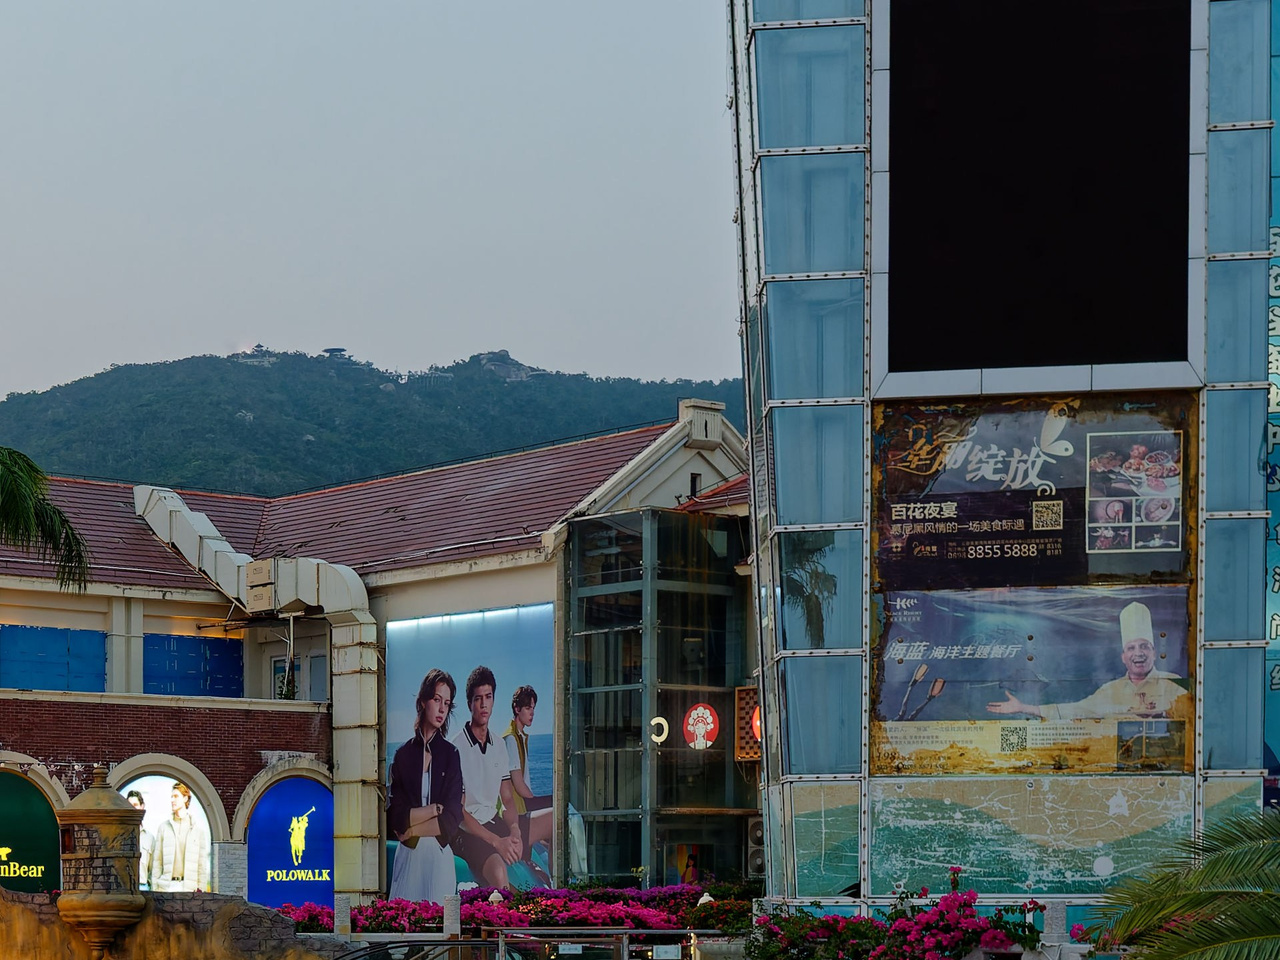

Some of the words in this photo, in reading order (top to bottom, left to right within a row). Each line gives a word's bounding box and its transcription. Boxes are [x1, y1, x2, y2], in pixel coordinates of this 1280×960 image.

[890, 502, 958, 520] 百花夜宴
[967, 545, 1001, 558] 8855
[1004, 544, 1037, 557] 5888
[929, 644, 1023, 660] 海洋主题餐厅
[266, 869, 331, 882] POLOWALK
